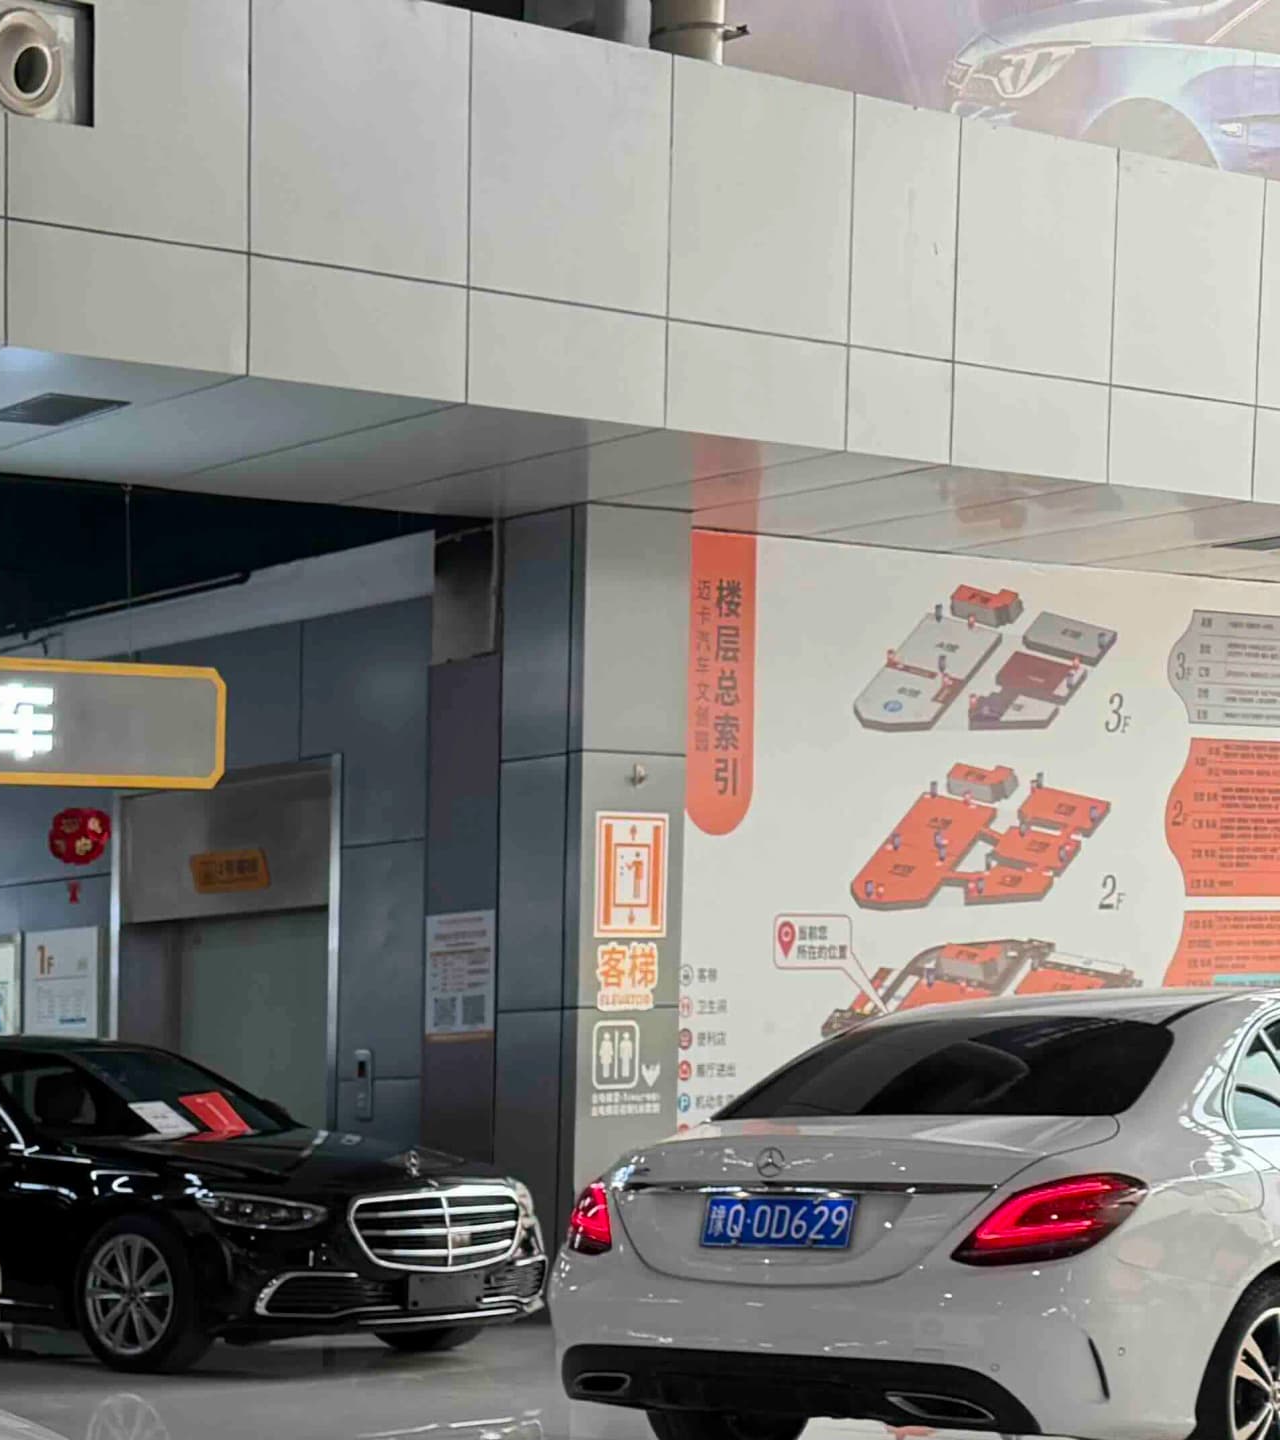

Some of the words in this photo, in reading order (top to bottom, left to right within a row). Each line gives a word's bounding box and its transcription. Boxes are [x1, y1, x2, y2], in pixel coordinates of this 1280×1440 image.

[715, 578, 742, 797] 楼层总索引
[1104, 692, 1132, 734] 3F
[1097, 874, 1127, 911] 2F
[600, 945, 657, 989] 客梯
